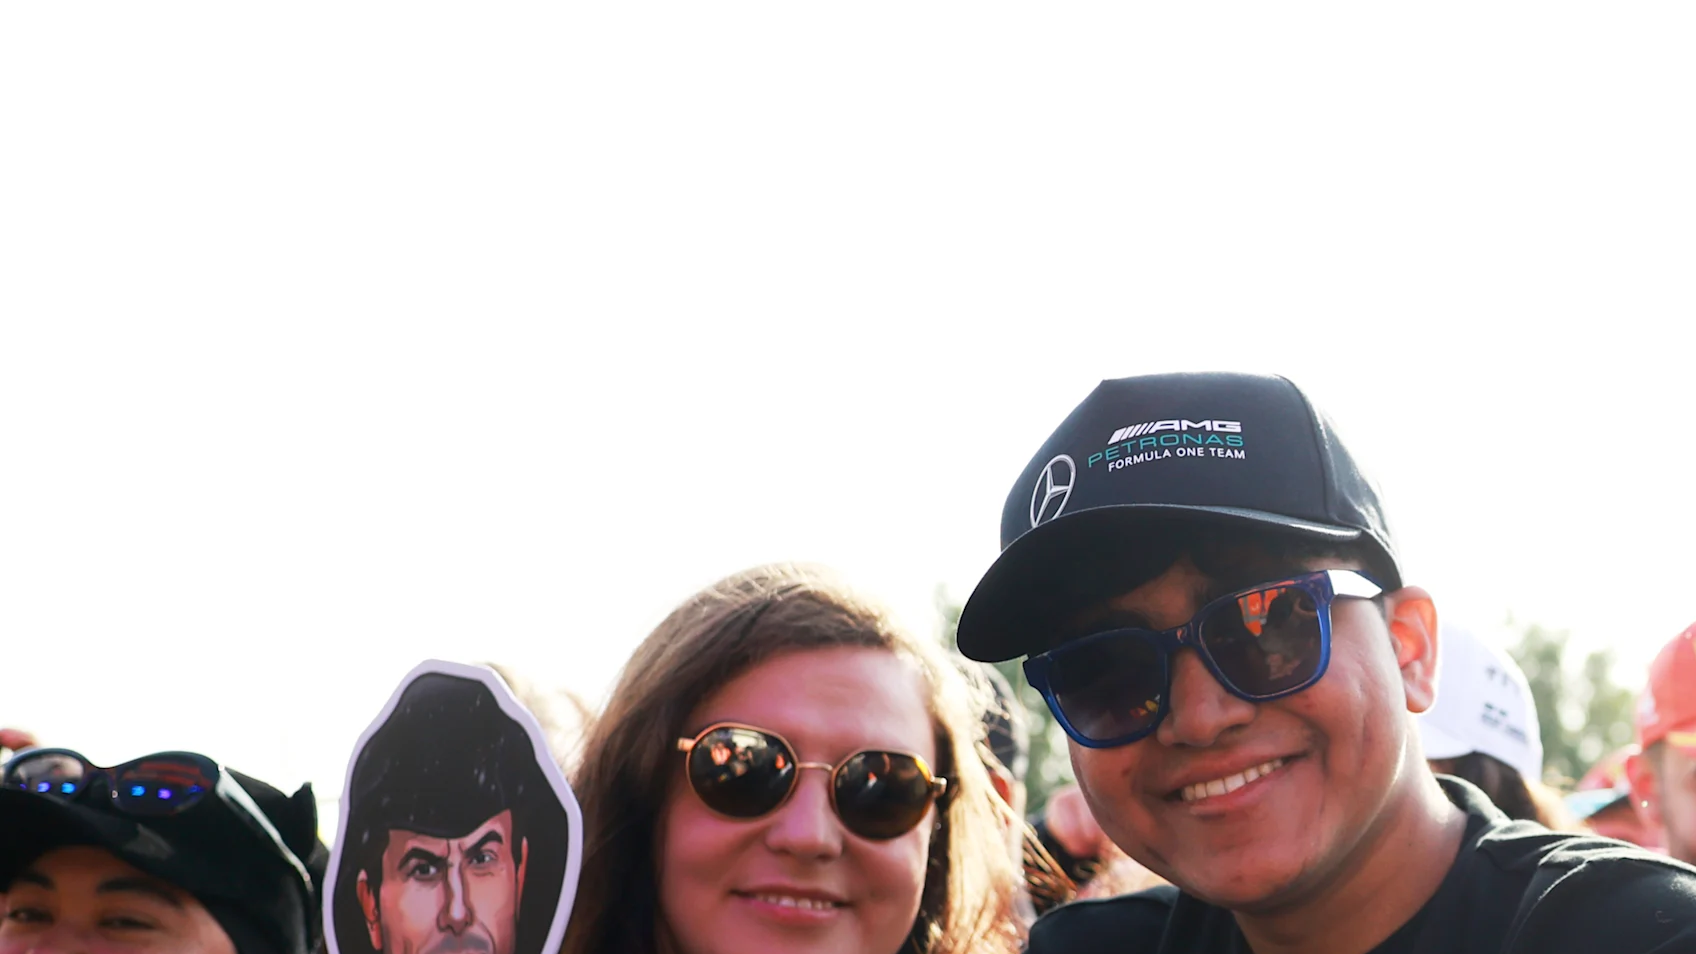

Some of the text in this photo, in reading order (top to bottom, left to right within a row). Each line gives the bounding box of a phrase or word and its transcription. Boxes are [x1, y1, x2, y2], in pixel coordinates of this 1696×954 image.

[1151, 420, 1242, 434] AMG
[1088, 433, 1244, 468] PETRONAS
[1108, 447, 1246, 472] FORMULA ONE TEAM
